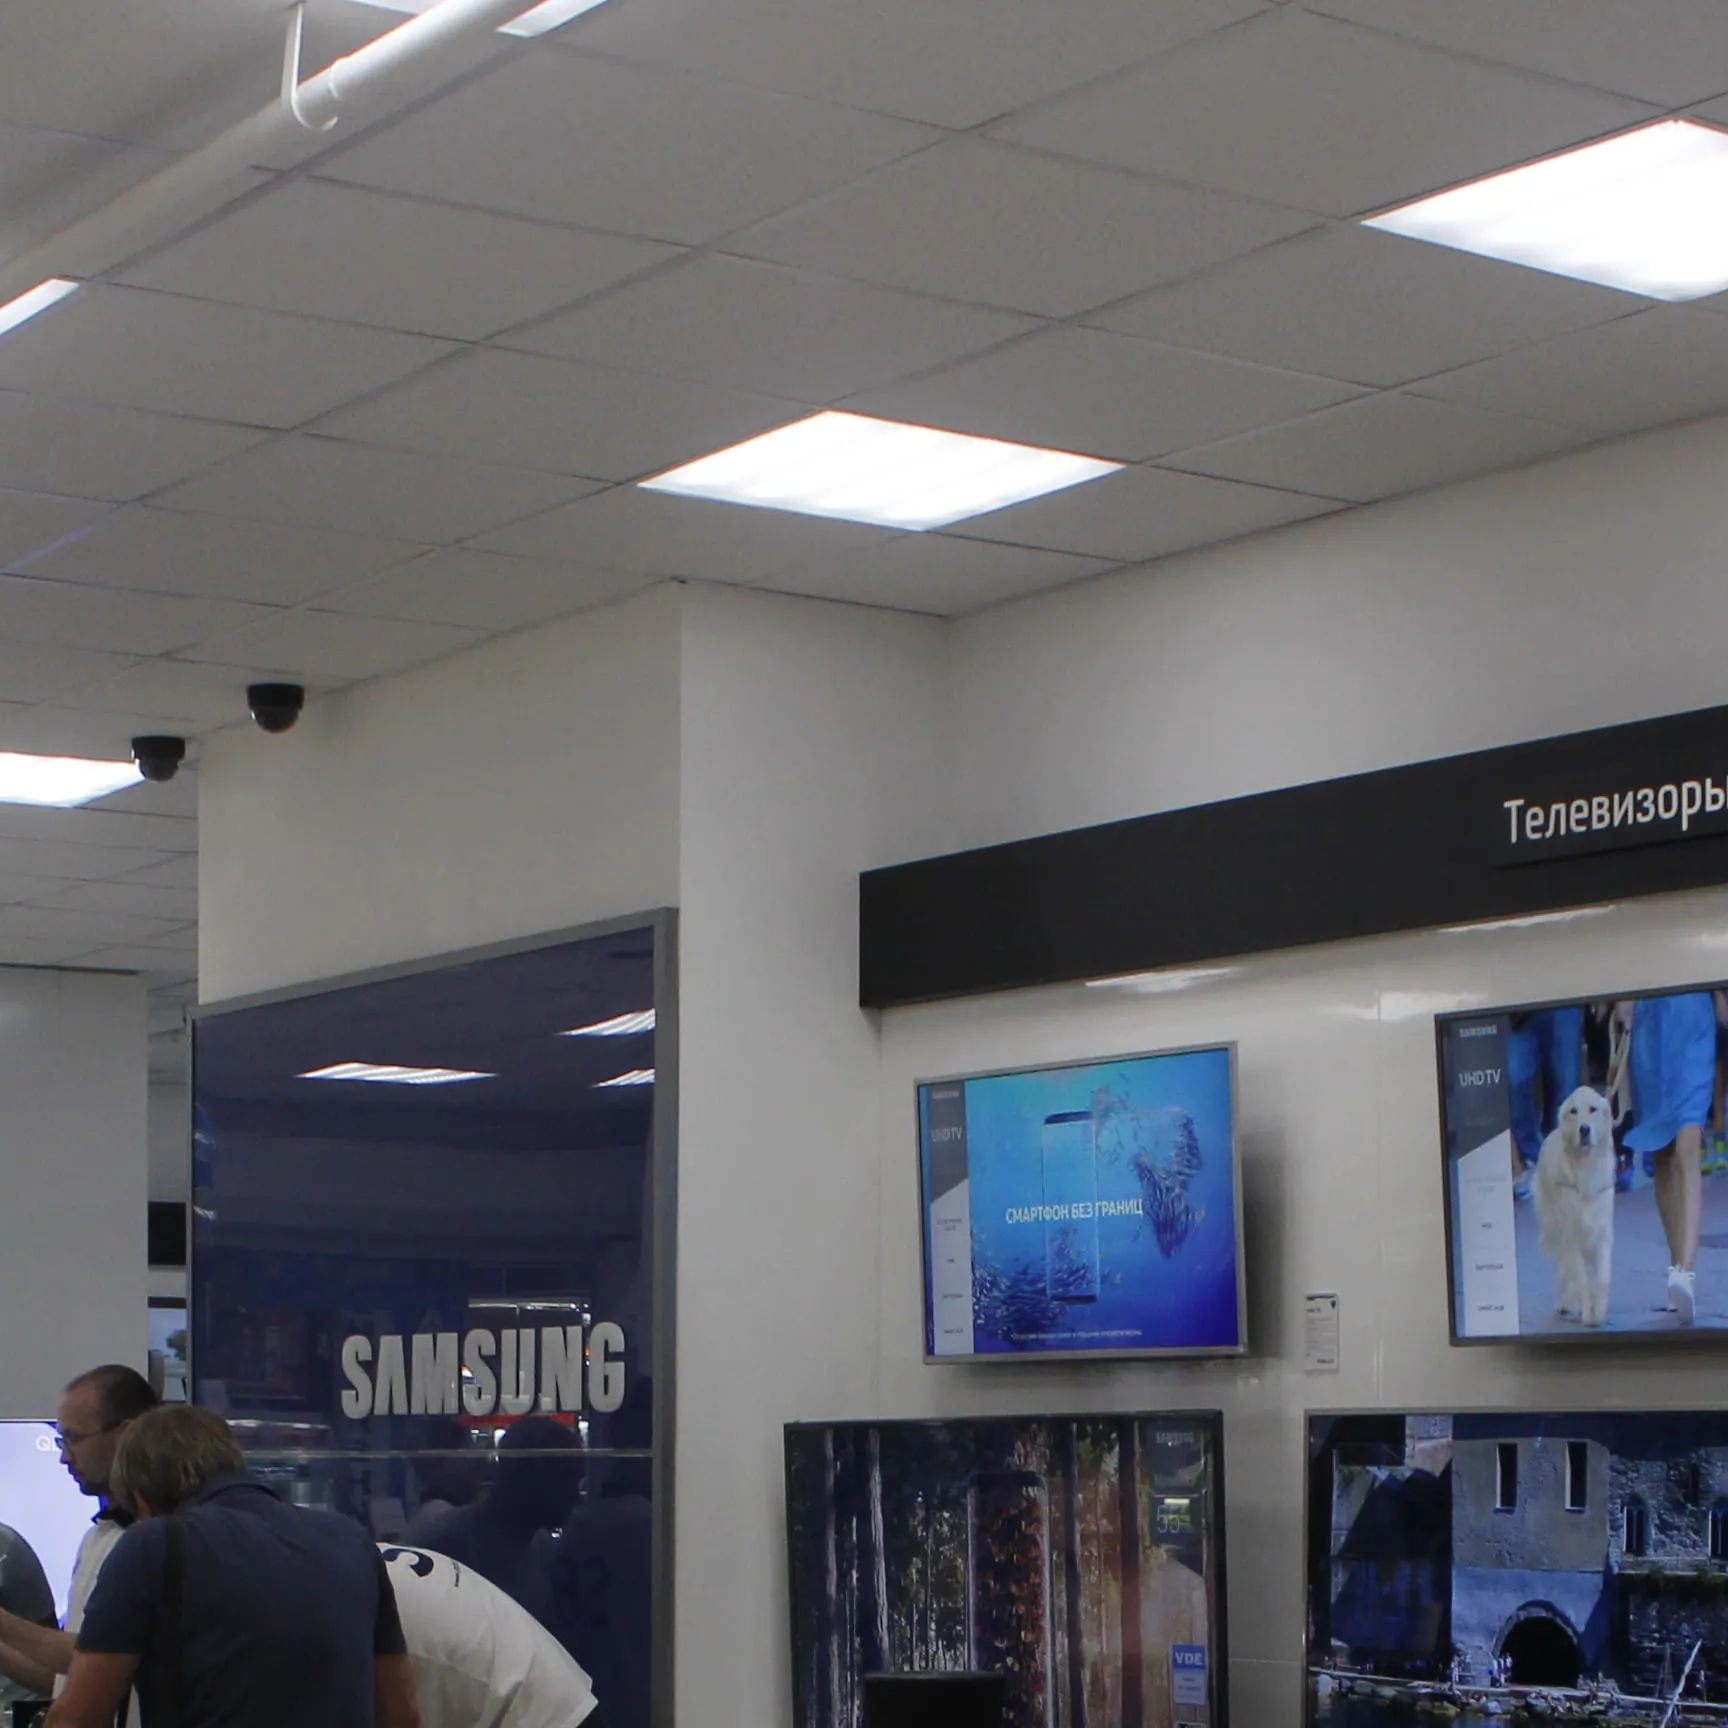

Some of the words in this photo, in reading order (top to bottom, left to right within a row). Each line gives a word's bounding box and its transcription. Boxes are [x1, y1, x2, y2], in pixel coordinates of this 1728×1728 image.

[1458, 1070, 1485, 1088] UHD
[1484, 1068, 1502, 1085] TV
[1005, 1204, 1069, 1224] СМАРТФОН
[1071, 1202, 1094, 1219] БЕЗ
[1094, 1198, 1144, 1217] ГРАНИЦ
[341, 1321, 626, 1420] SAMSUNG
[1174, 1651, 1204, 1667] VDE
